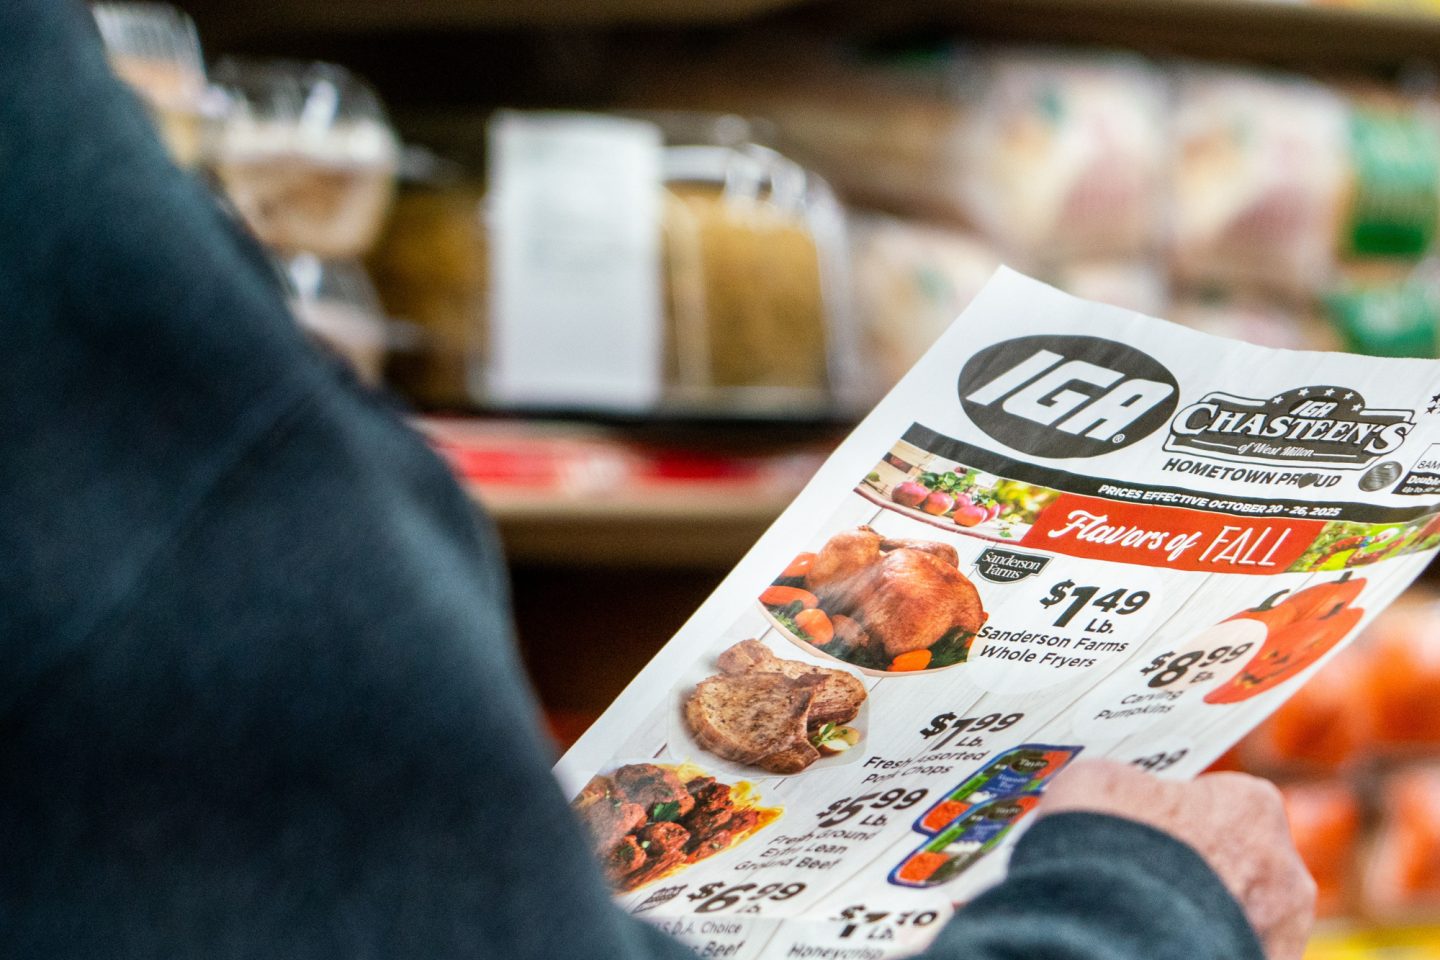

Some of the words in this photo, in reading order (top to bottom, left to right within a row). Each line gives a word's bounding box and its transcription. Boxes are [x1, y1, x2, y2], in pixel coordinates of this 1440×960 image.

[966, 349, 1174, 441] IGA
[1289, 400, 1338, 418] IGA
[1172, 402, 1417, 455] CHASTEEN'S
[1253, 443, 1281, 456] West
[1162, 458, 1278, 485] HOMETOWN
[1098, 484, 1143, 500] PRICES
[1142, 489, 1209, 507] EFFECTIVE
[1209, 499, 1267, 514] OCTOBER
[1267, 504, 1284, 514] 20
[1311, 507, 1341, 517] 2025
[1048, 509, 1168, 548] Flavors
[1164, 530, 1203, 561] of
[1198, 525, 1292, 566] FALL
[982, 551, 1041, 571] Sanderson
[984, 563, 1023, 579] Farms
[1084, 618, 1114, 634] Lb.
[978, 626, 1071, 648] Sanderson
[1074, 637, 1129, 652] Farms
[980, 645, 1037, 663] Whole
[1039, 653, 1097, 669] Fryers
[863, 756, 912, 769] Fresh
[701, 920, 743, 934] Choice
